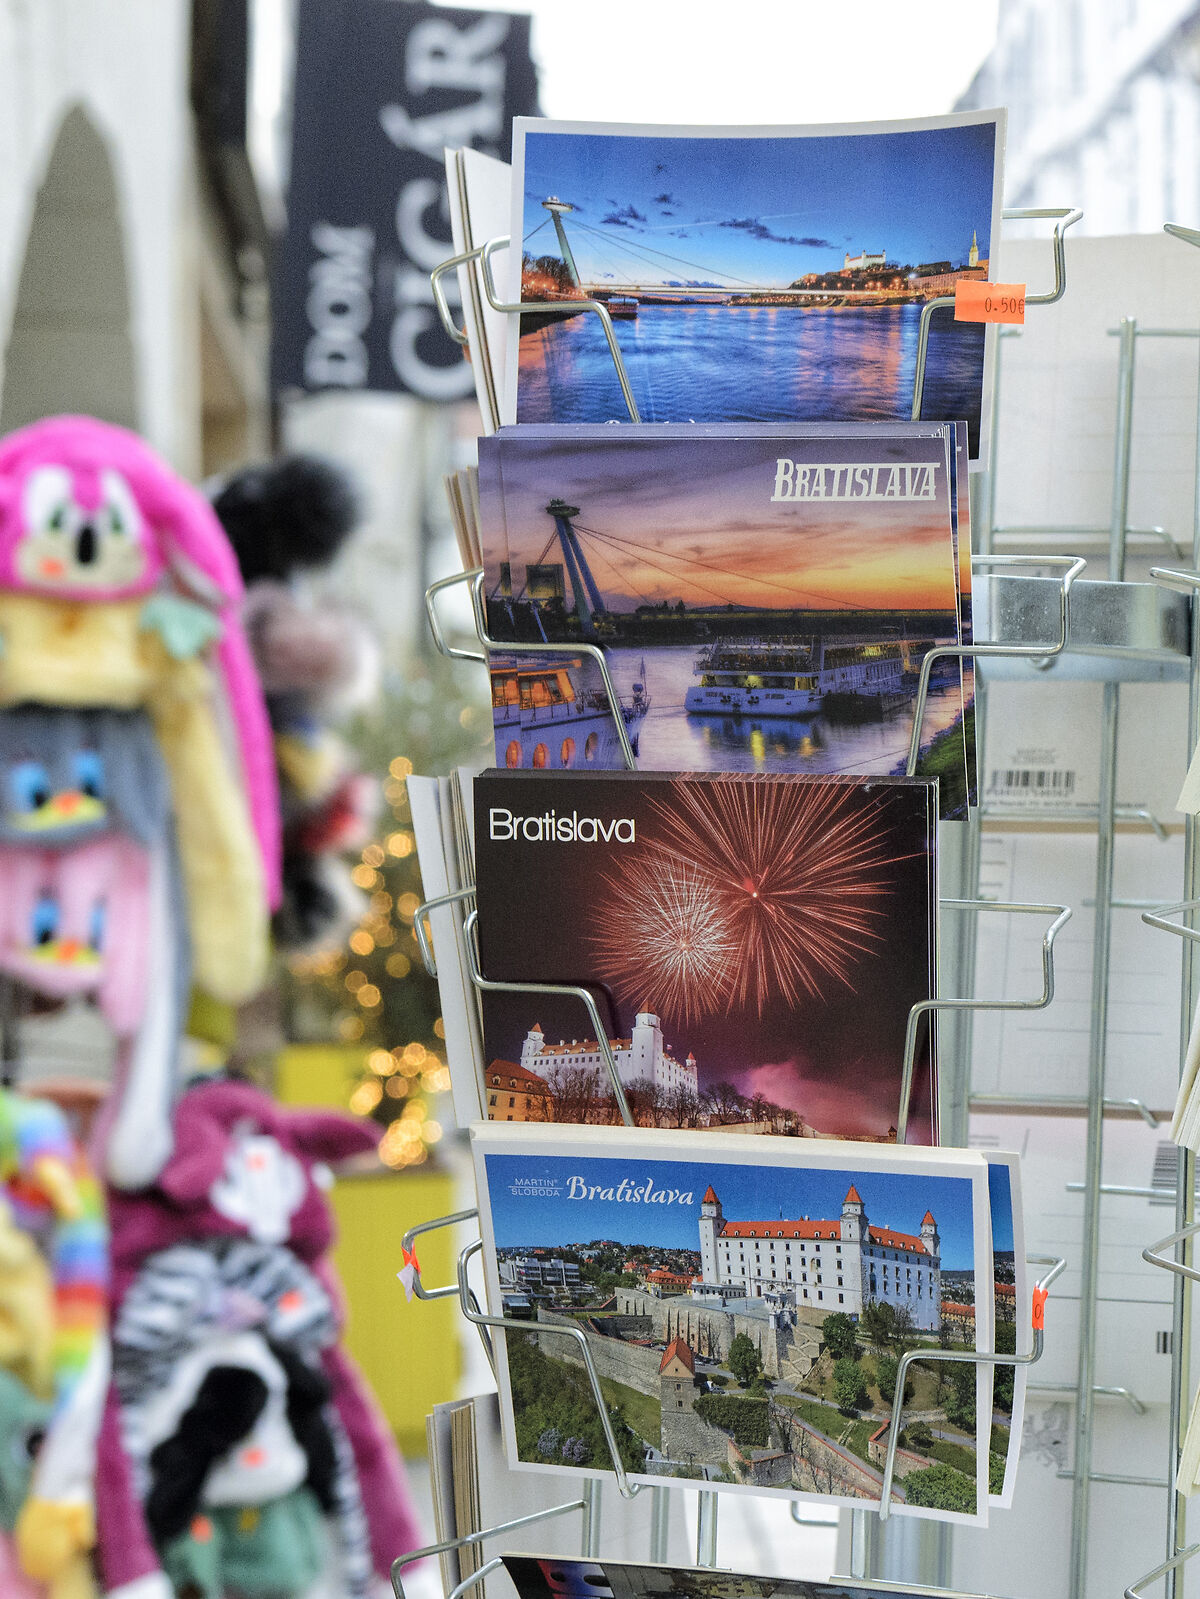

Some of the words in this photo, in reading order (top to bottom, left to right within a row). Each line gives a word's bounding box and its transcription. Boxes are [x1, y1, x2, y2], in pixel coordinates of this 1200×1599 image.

[305, 224, 375, 389] DOM
[984, 296, 1026, 315] 0.50€
[489, 808, 636, 844] Bratislava
[511, 1187, 561, 1198] SLOBODA
[566, 1175, 695, 1206] Bratislava
